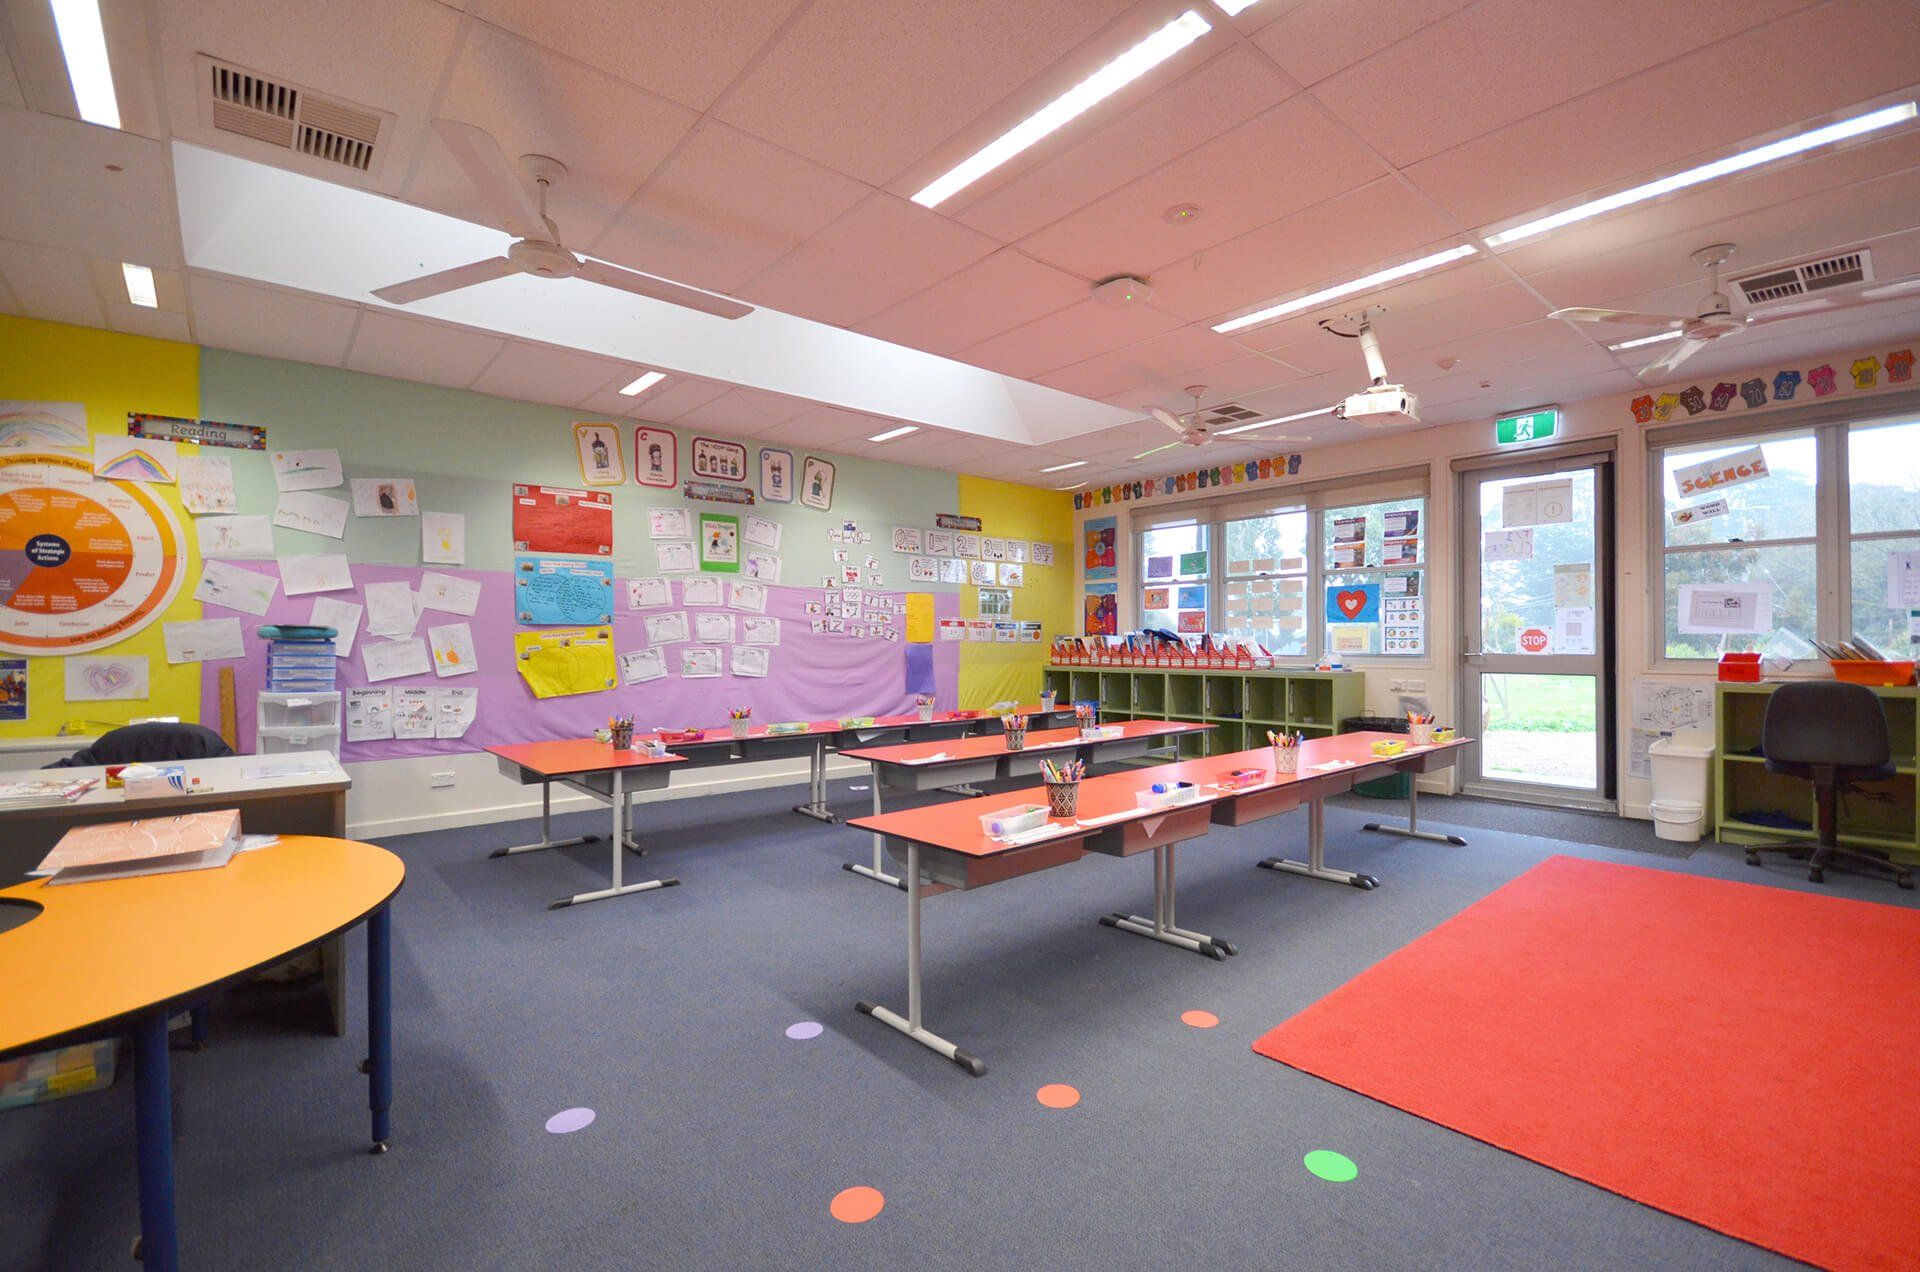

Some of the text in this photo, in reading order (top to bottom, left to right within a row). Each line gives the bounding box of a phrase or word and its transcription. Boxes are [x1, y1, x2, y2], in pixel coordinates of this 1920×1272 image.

[1749, 388, 1762, 403] 70
[1688, 396, 1702, 411] 50
[171, 424, 227, 440] Reading
[578, 429, 588, 438] V
[640, 432, 648, 441] C
[38, 457, 63, 465] Within
[808, 460, 815, 468] P
[707, 489, 734, 499] Writing
[895, 529, 905, 546] 0
[956, 536, 967, 553] 2
[984, 539, 993, 556] 3
[1007, 541, 1017, 558] 4
[1033, 543, 1042, 561] 5
[911, 559, 922, 577] 6
[943, 560, 954, 577] 7
[972, 562, 986, 580] 8
[1906, 561, 1911, 570] K
[1522, 635, 1546, 645] STOP
